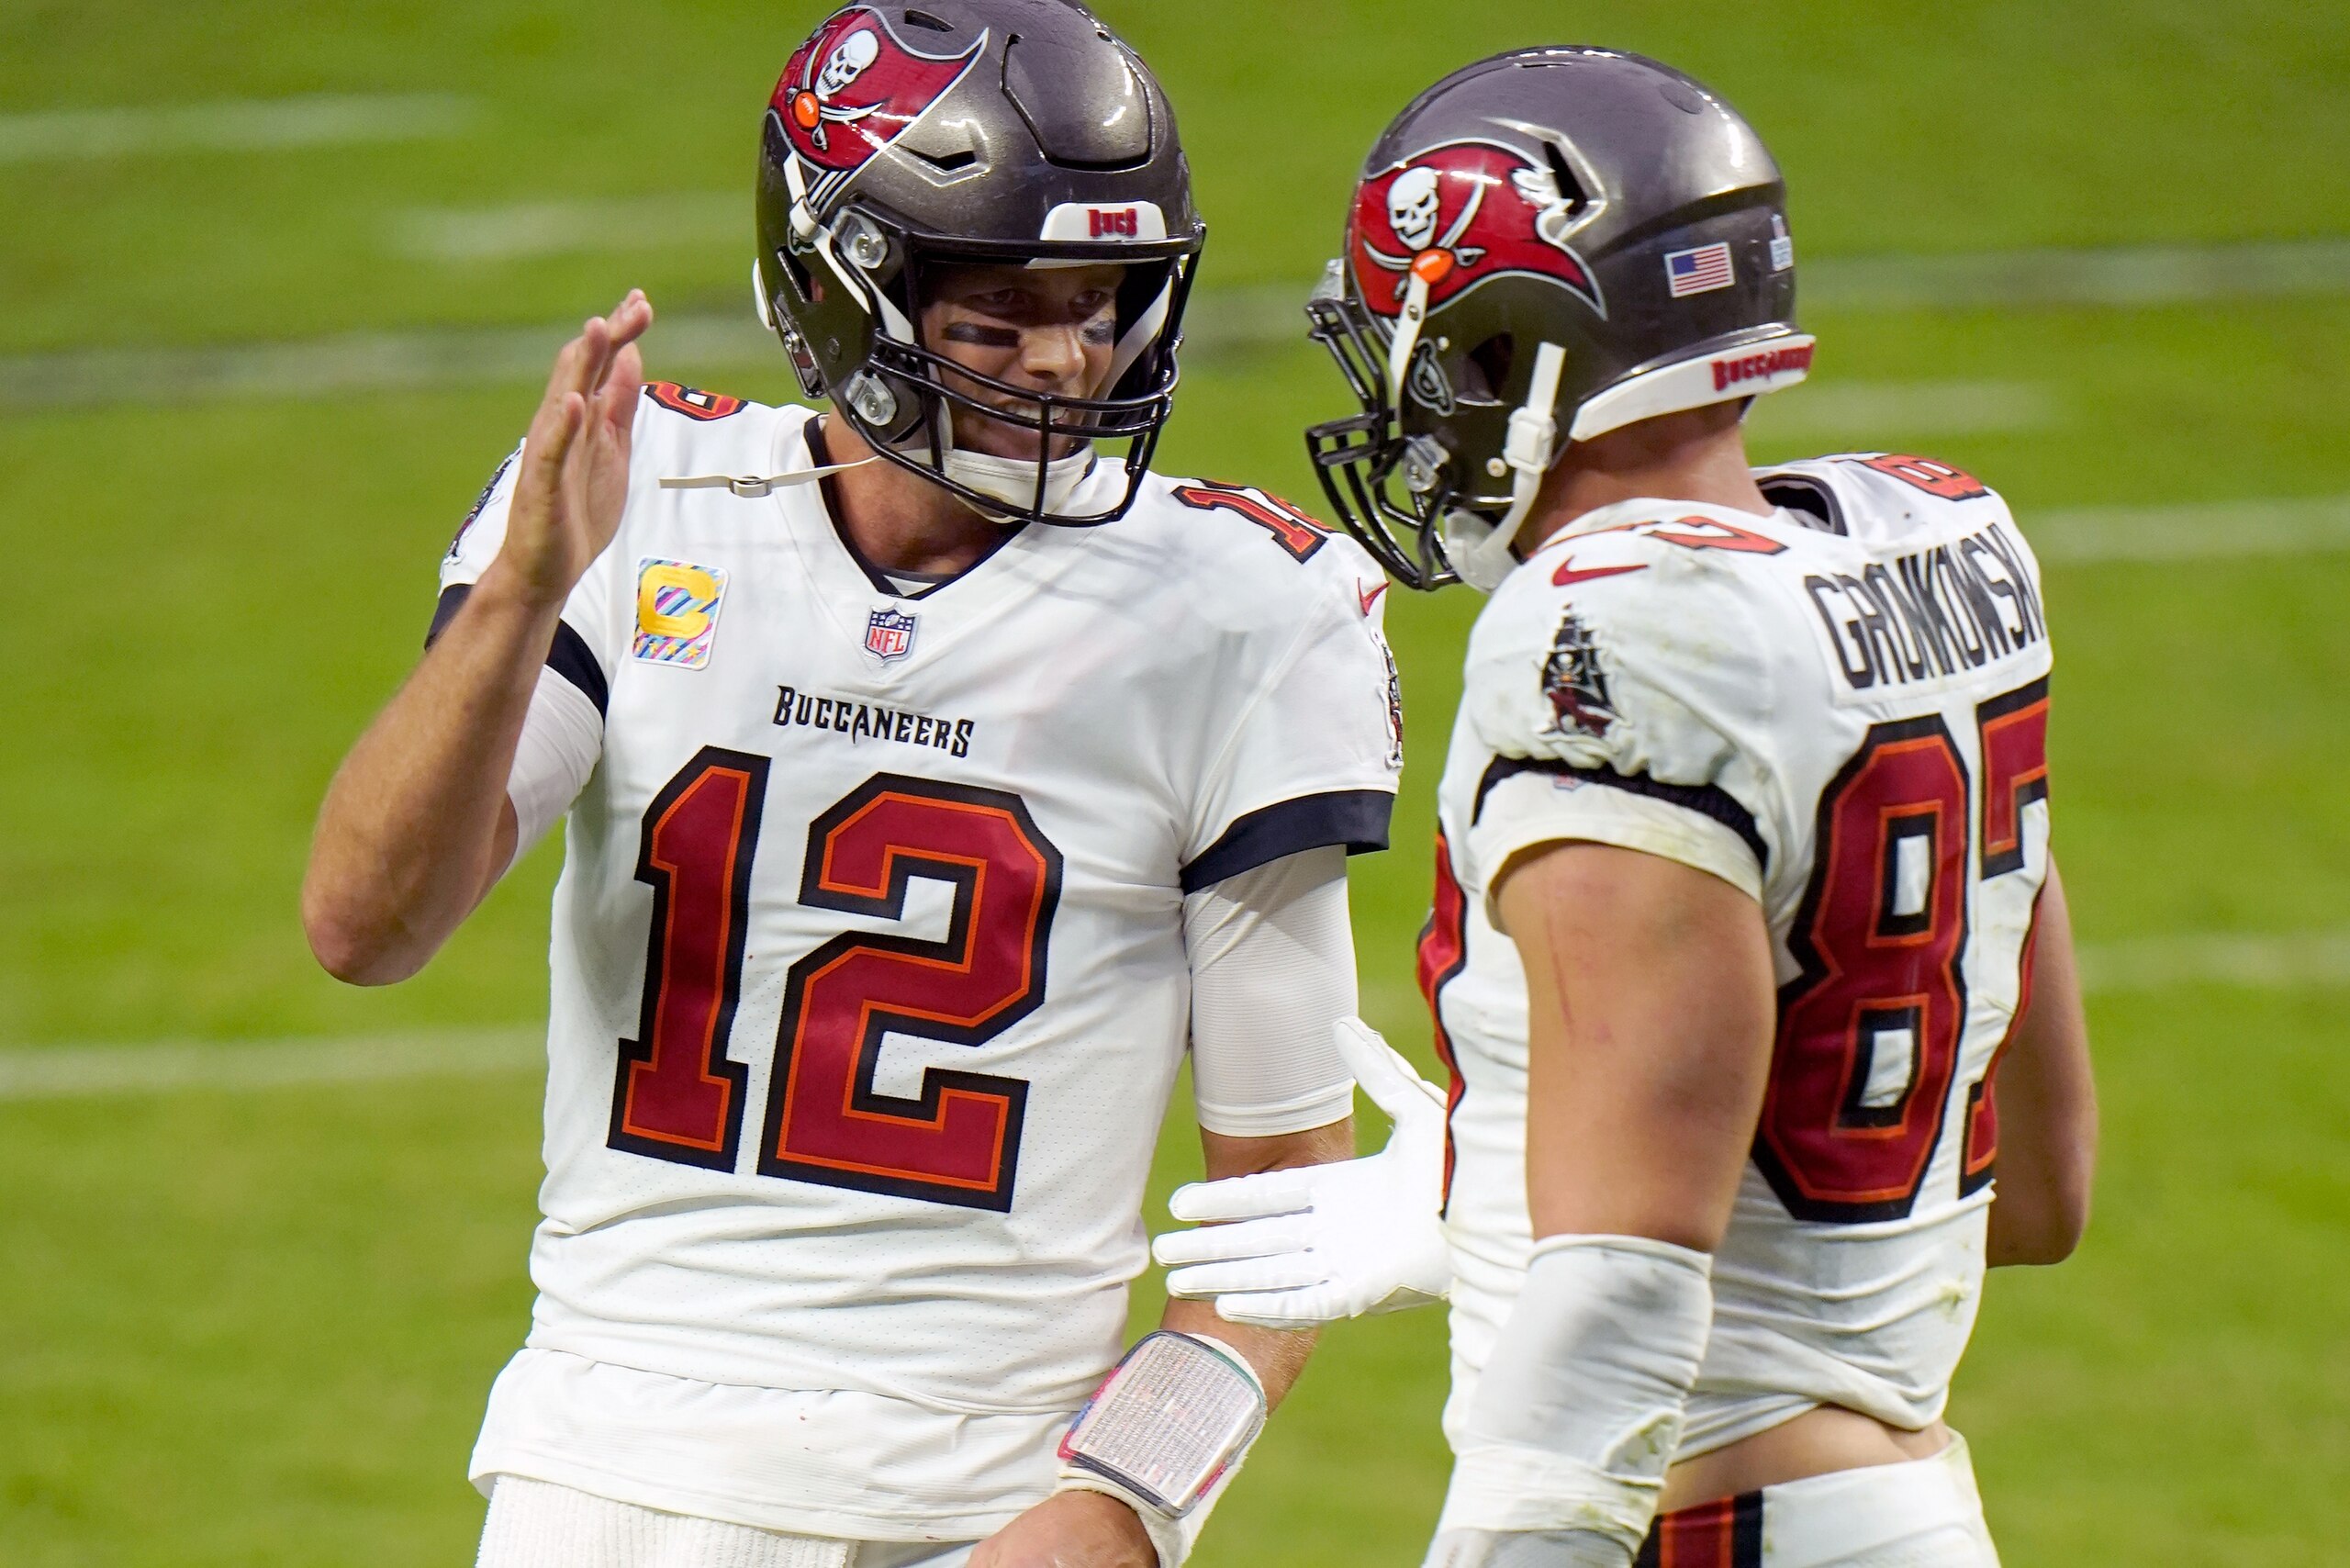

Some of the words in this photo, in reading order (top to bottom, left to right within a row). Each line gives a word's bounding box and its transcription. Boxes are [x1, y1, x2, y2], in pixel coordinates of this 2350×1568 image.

[638, 564, 720, 638] C
[869, 627, 905, 653] NFL
[773, 685, 974, 758] BUCCANEERS
[606, 745, 1064, 1213] 12
